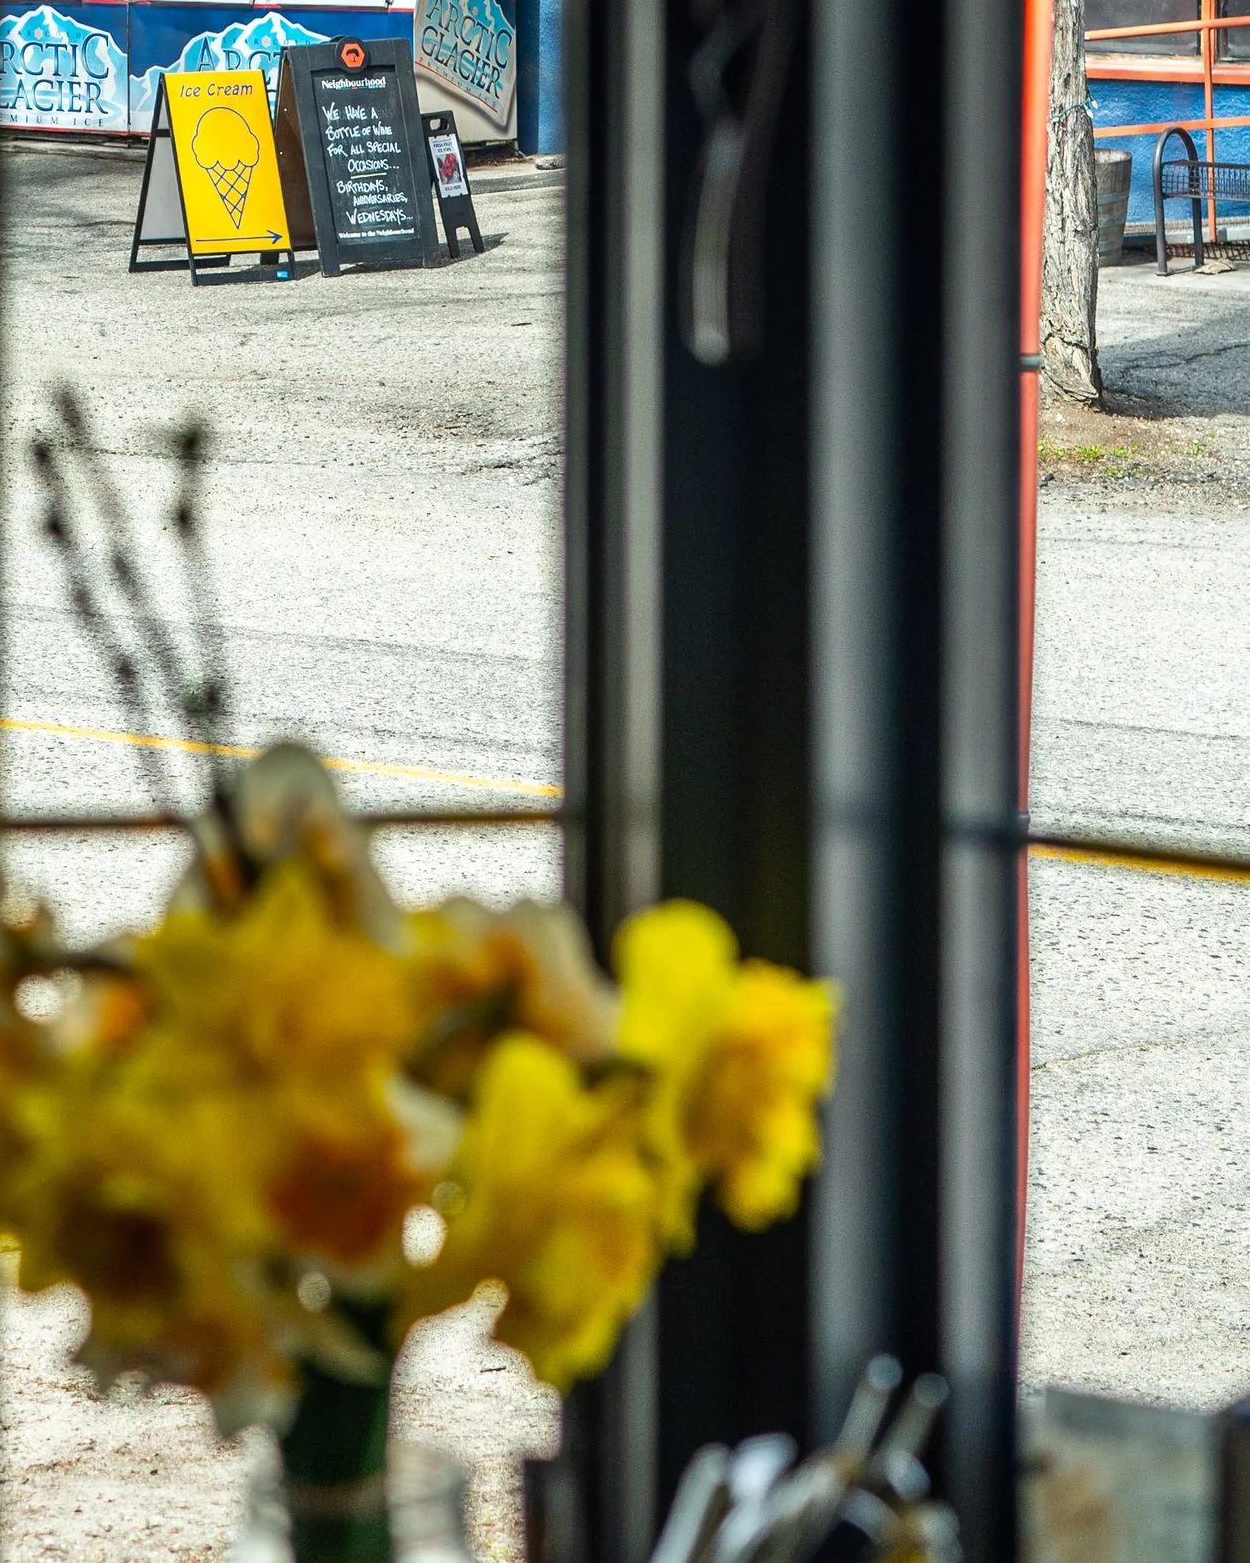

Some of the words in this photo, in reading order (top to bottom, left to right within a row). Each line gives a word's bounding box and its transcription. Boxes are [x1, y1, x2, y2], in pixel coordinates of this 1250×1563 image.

[198, 36, 282, 85] ARC
[420, 25, 502, 100] GLACIER
[180, 84, 201, 98] Ice
[207, 83, 254, 97] Cream
[321, 76, 386, 90] Neighbourhood
[322, 102, 340, 121] WE
[345, 105, 367, 120] HAVE
[371, 106, 379, 120] A
[73, 118, 104, 128] ICE
[325, 125, 361, 141] BOTTLE
[362, 126, 372, 136] OF
[372, 121, 393, 136] WINE
[327, 143, 349, 158] FOR
[350, 144, 365, 156] ALL
[366, 141, 402, 154] SPECIAL
[336, 179, 389, 194] BIRTHDAYS,
